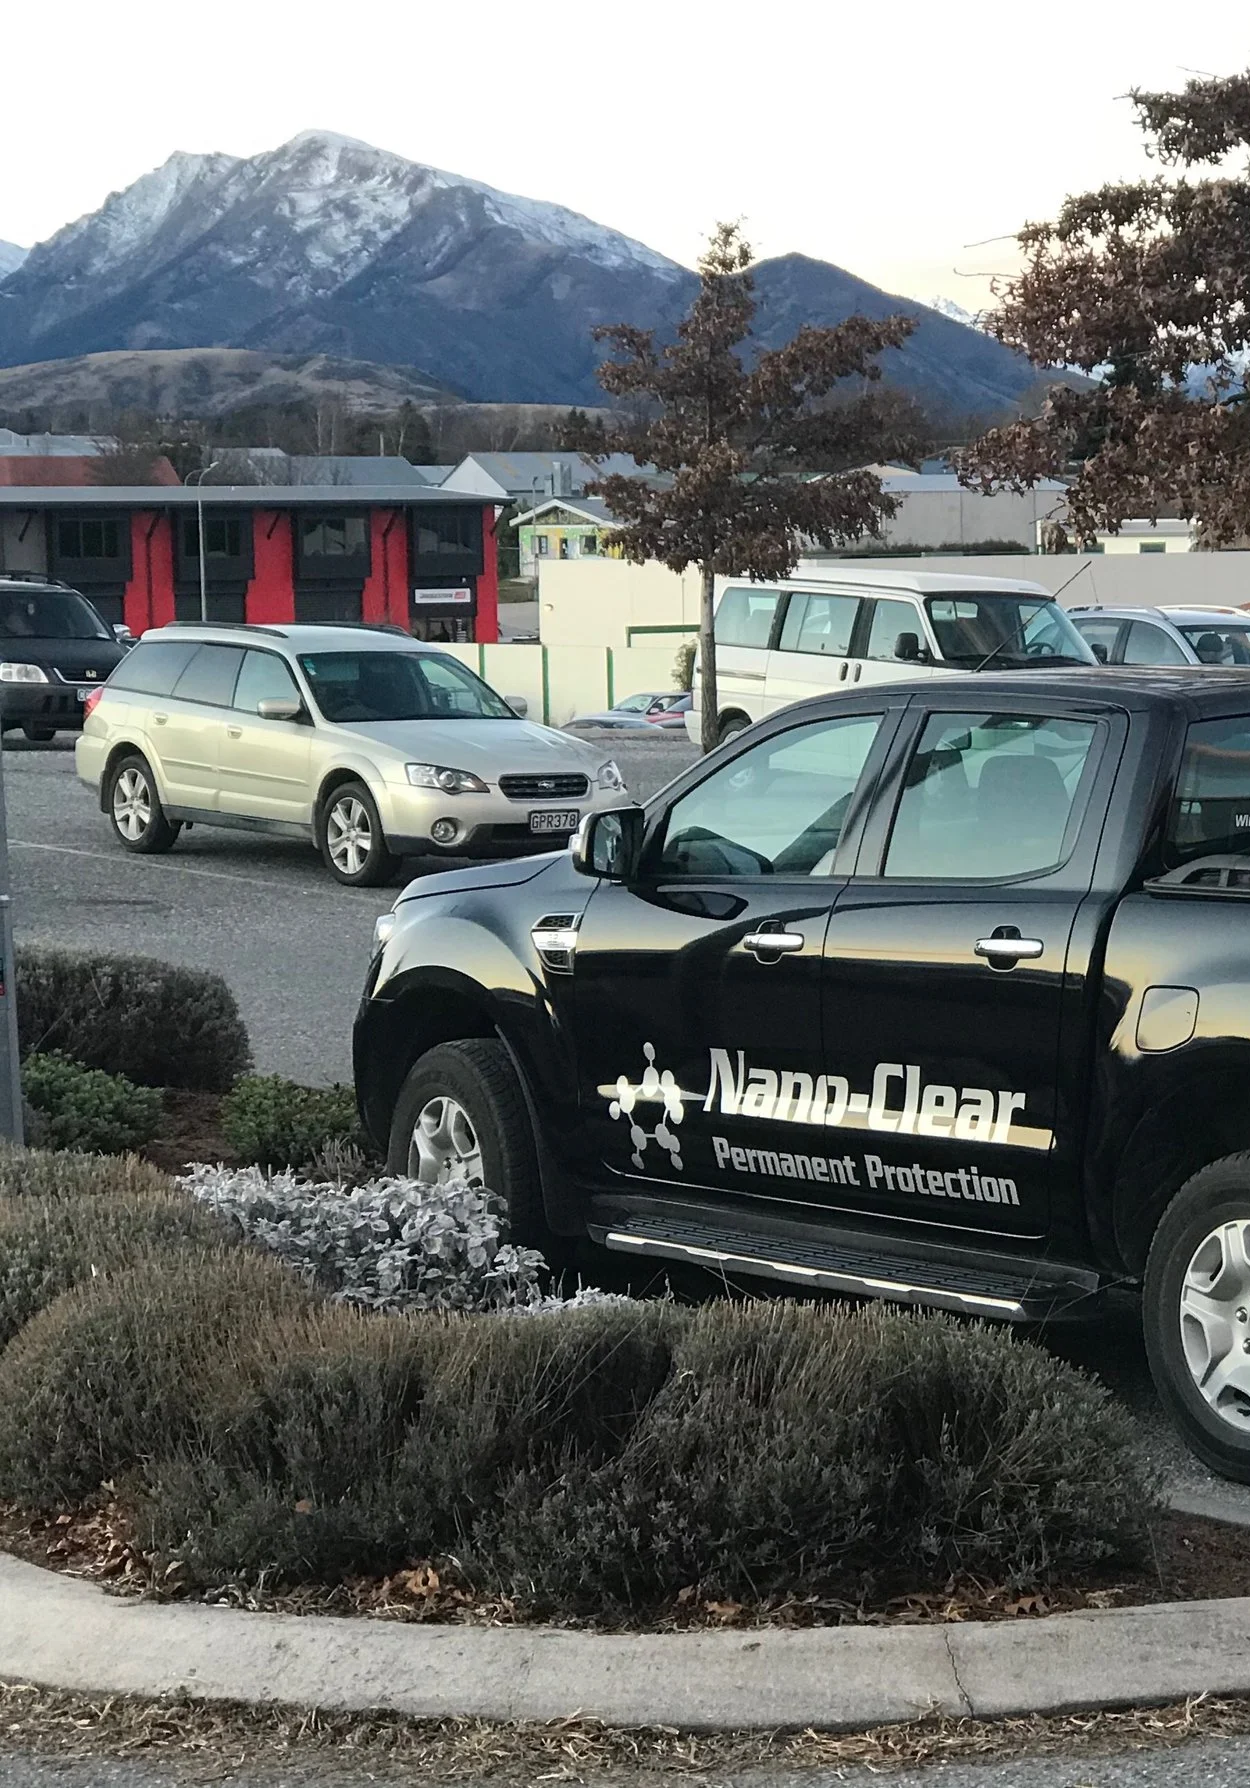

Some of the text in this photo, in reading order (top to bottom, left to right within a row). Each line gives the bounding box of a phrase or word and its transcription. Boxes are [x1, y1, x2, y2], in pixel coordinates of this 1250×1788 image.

[531, 812, 576, 831] GPR378
[702, 1047, 1026, 1144] Nano-Clear
[711, 1136, 860, 1186] Permanent
[864, 1154, 1021, 1206] Protection
